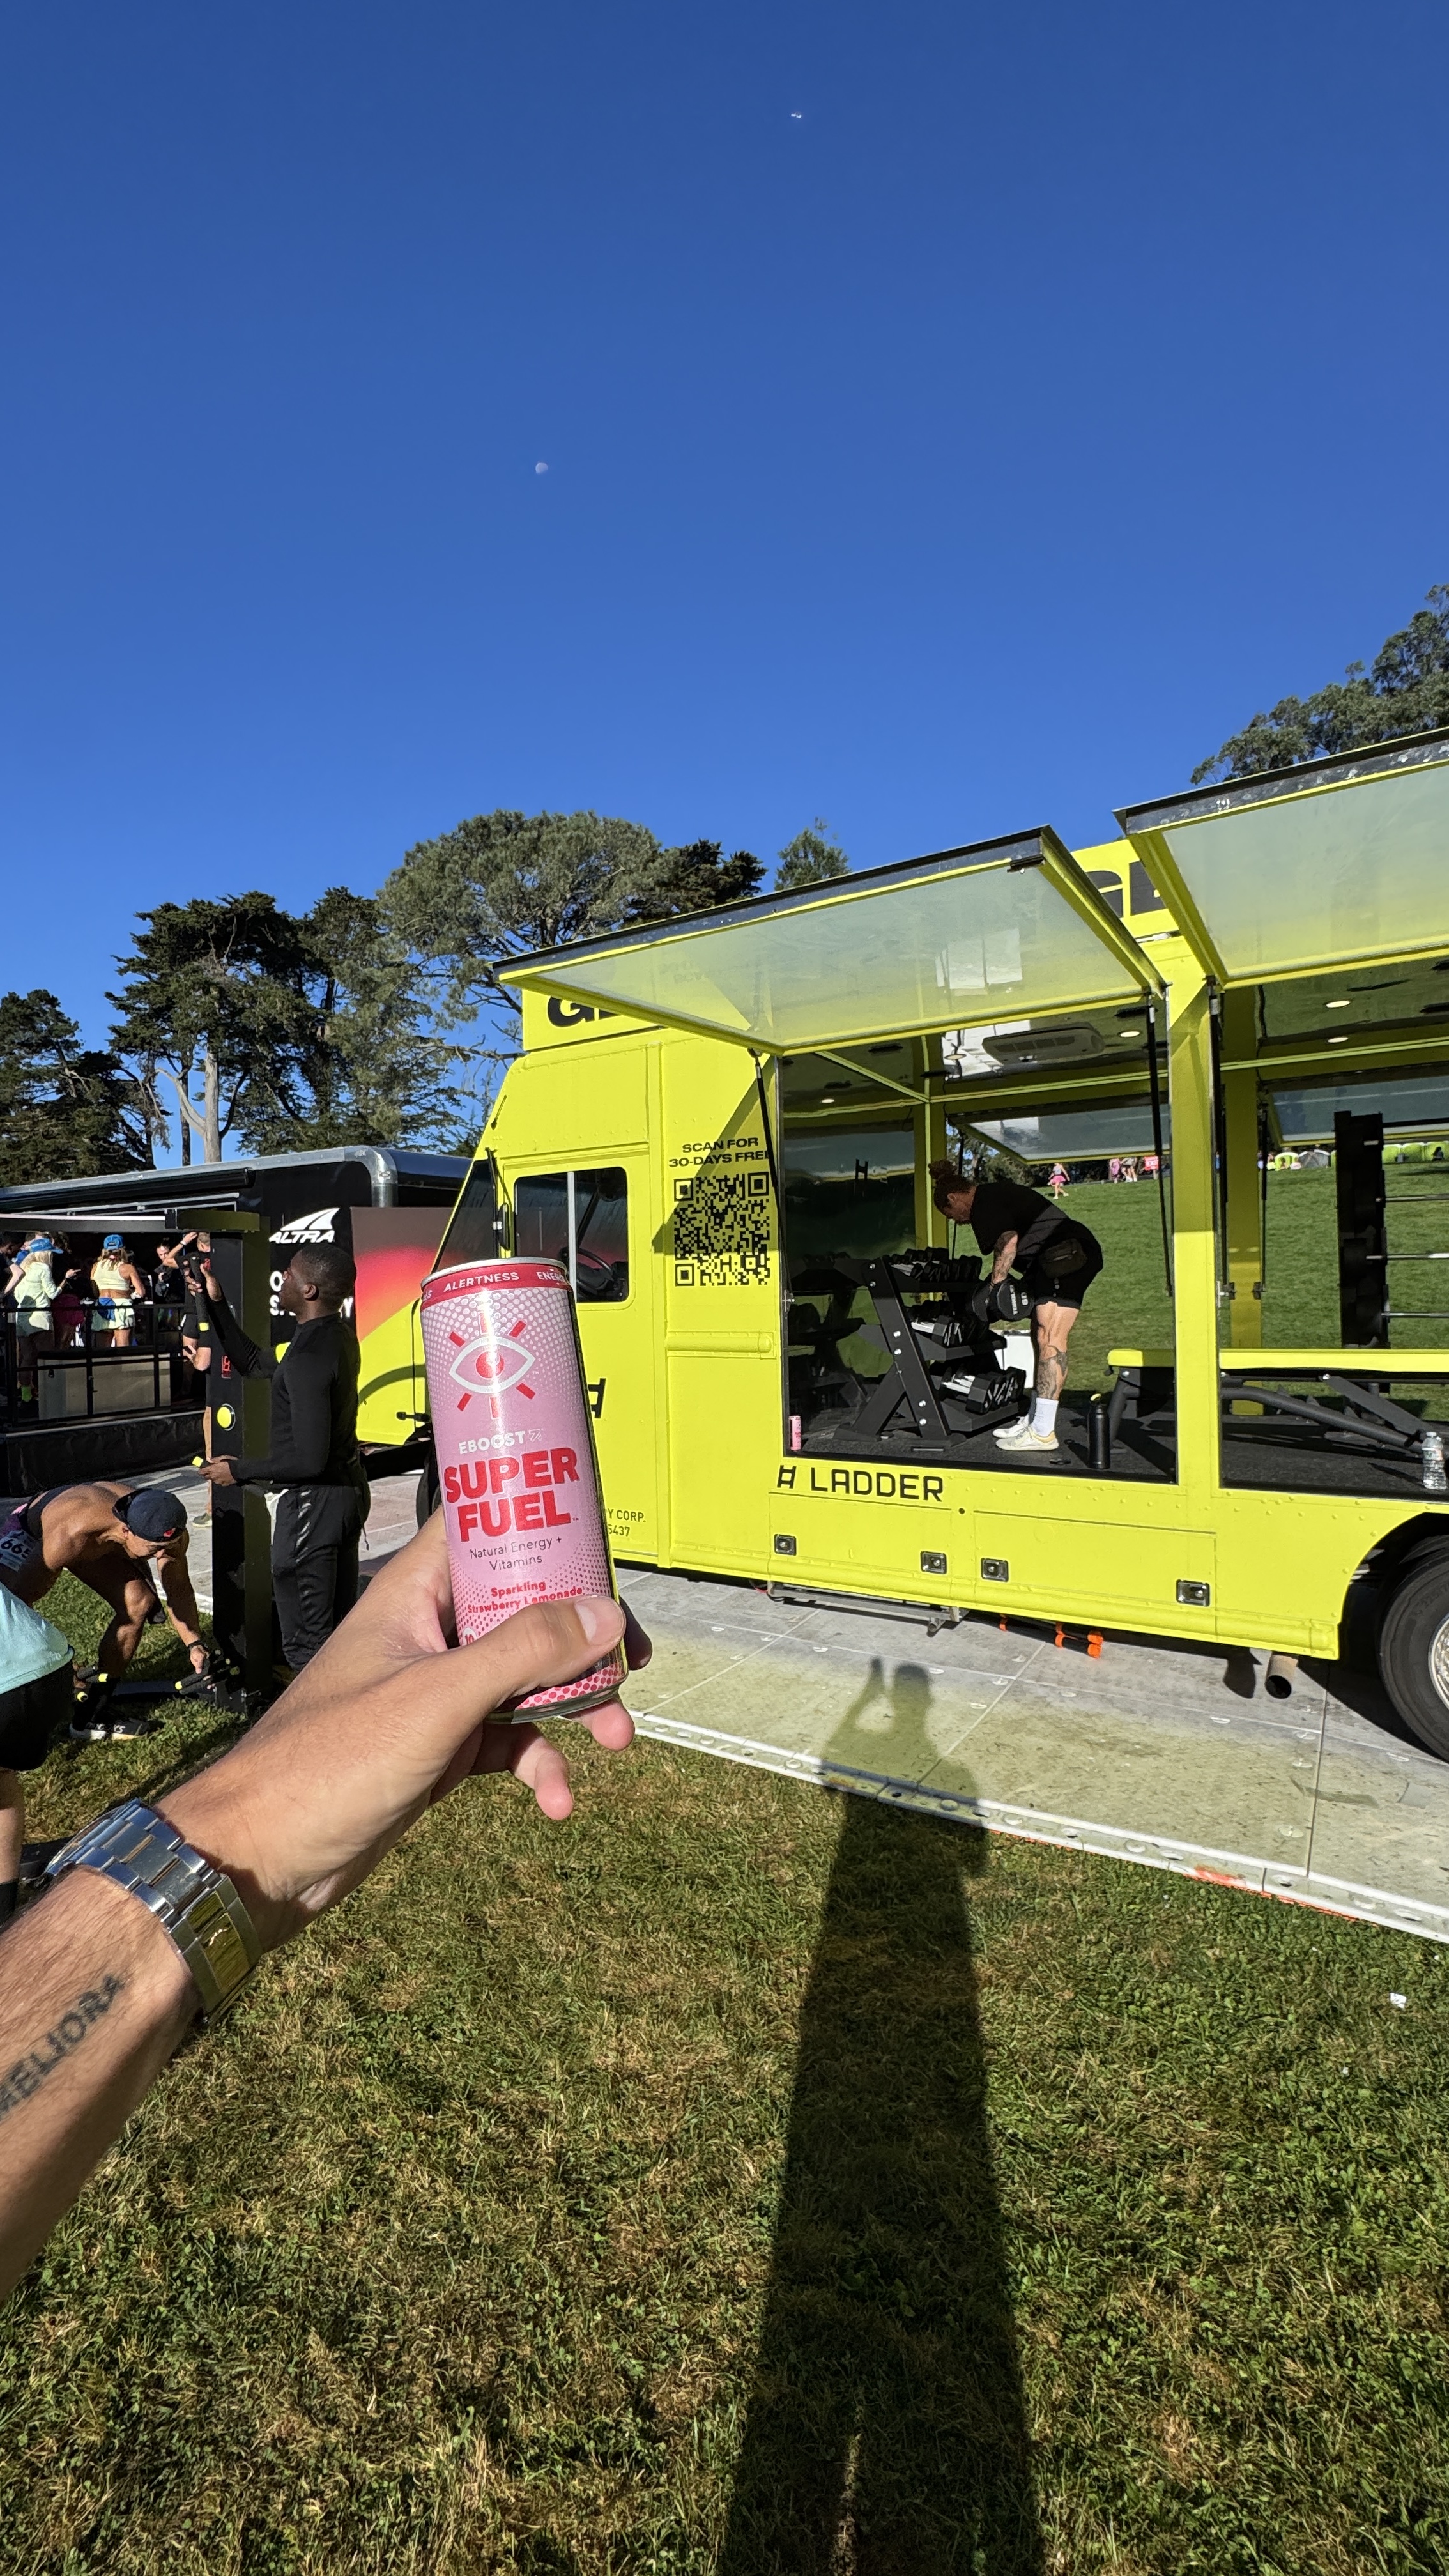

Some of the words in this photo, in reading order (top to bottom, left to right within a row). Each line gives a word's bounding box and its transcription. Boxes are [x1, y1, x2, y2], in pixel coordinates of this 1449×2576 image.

[682, 1140, 724, 1153] SCAN
[727, 1137, 758, 1149] FOR
[669, 1153, 732, 1167] 30-DAYS
[269, 1230, 335, 1243] ALTRA
[443, 1272, 519, 1292] ALERTNESS
[458, 1430, 526, 1454] EBOOST
[444, 1447, 580, 1503] SUPER
[810, 1467, 943, 1502] LADDER
[617, 1510, 646, 1523] CORP.
[470, 1543, 507, 1559] Natural
[511, 1538, 553, 1553] Energy
[489, 1555, 543, 1571] Vitamins
[468, 1600, 521, 1614] Strawberry
[525, 1586, 583, 1604] Lemonade
[491, 1581, 546, 1600] Sparkling
